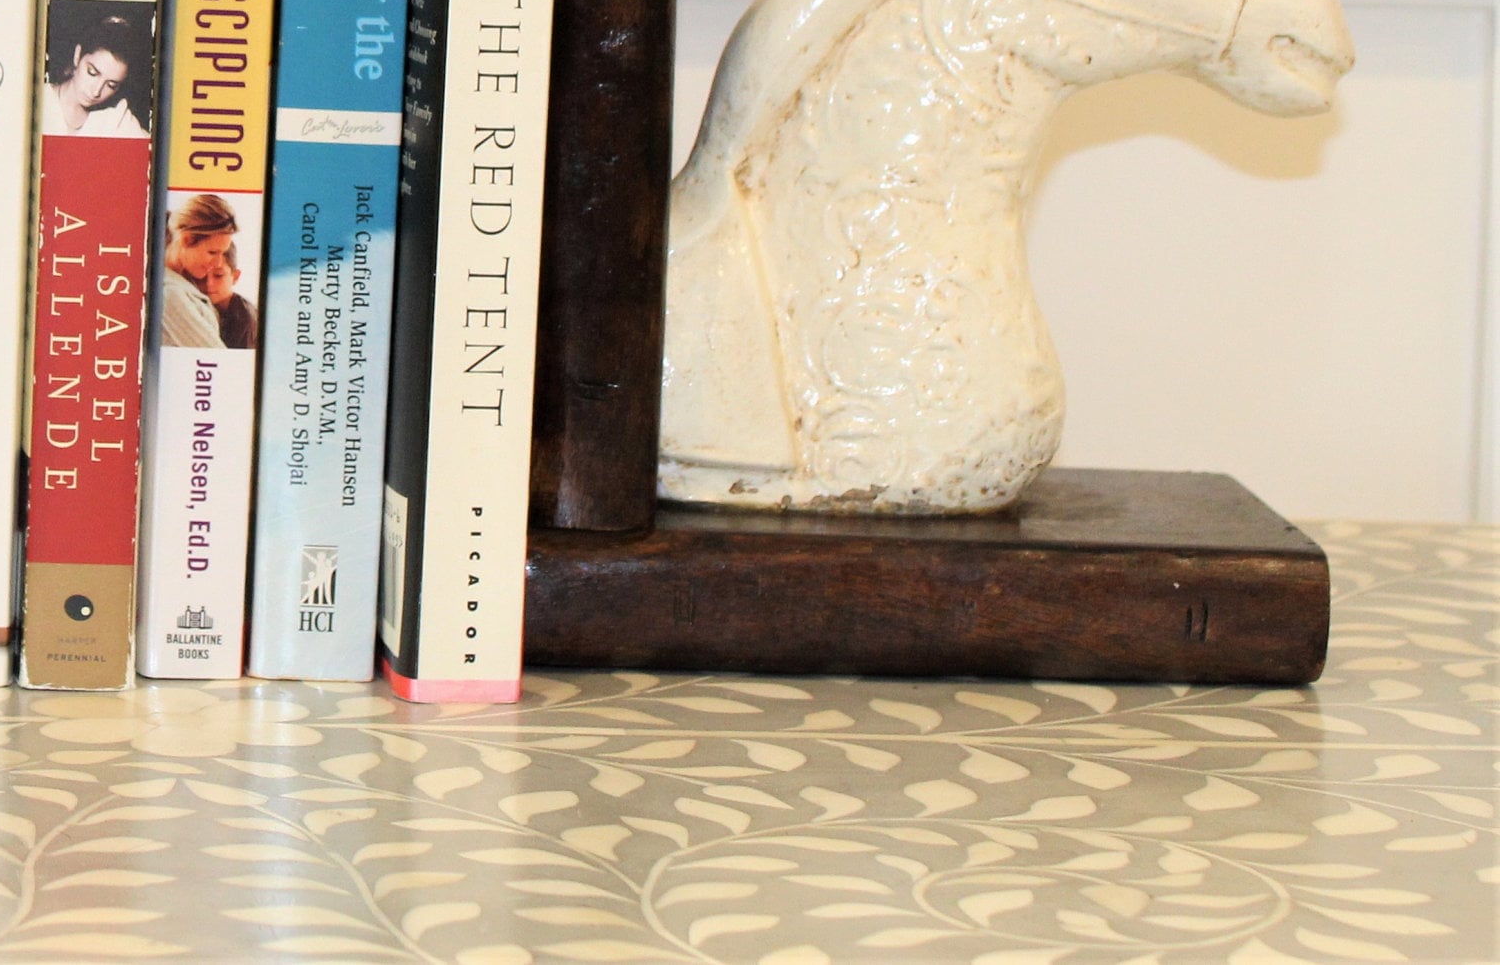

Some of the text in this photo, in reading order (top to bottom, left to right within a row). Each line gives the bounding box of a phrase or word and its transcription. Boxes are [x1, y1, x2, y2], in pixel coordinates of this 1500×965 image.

[354, 15, 397, 82] the
[468, 123, 517, 237] RED
[43, 206, 88, 491] ALLENDE
[90, 242, 132, 462] ISABEL
[287, 201, 320, 488] Carol Kline and Amy D. Shojai
[315, 243, 345, 446] Marty Becker, D.V.M.,
[342, 184, 374, 508] Jack Canfield, Mark Victor Hansen
[460, 255, 511, 428] TENT
[184, 358, 219, 580] Jane Nelsen, Ed.D.
[46, 653, 107, 663] PERENNIAL
[166, 633, 223, 646] BALLANTINE
[178, 648, 210, 660] BOOKS
[298, 611, 334, 634] HCI
[462, 506, 484, 666] PICADOR
